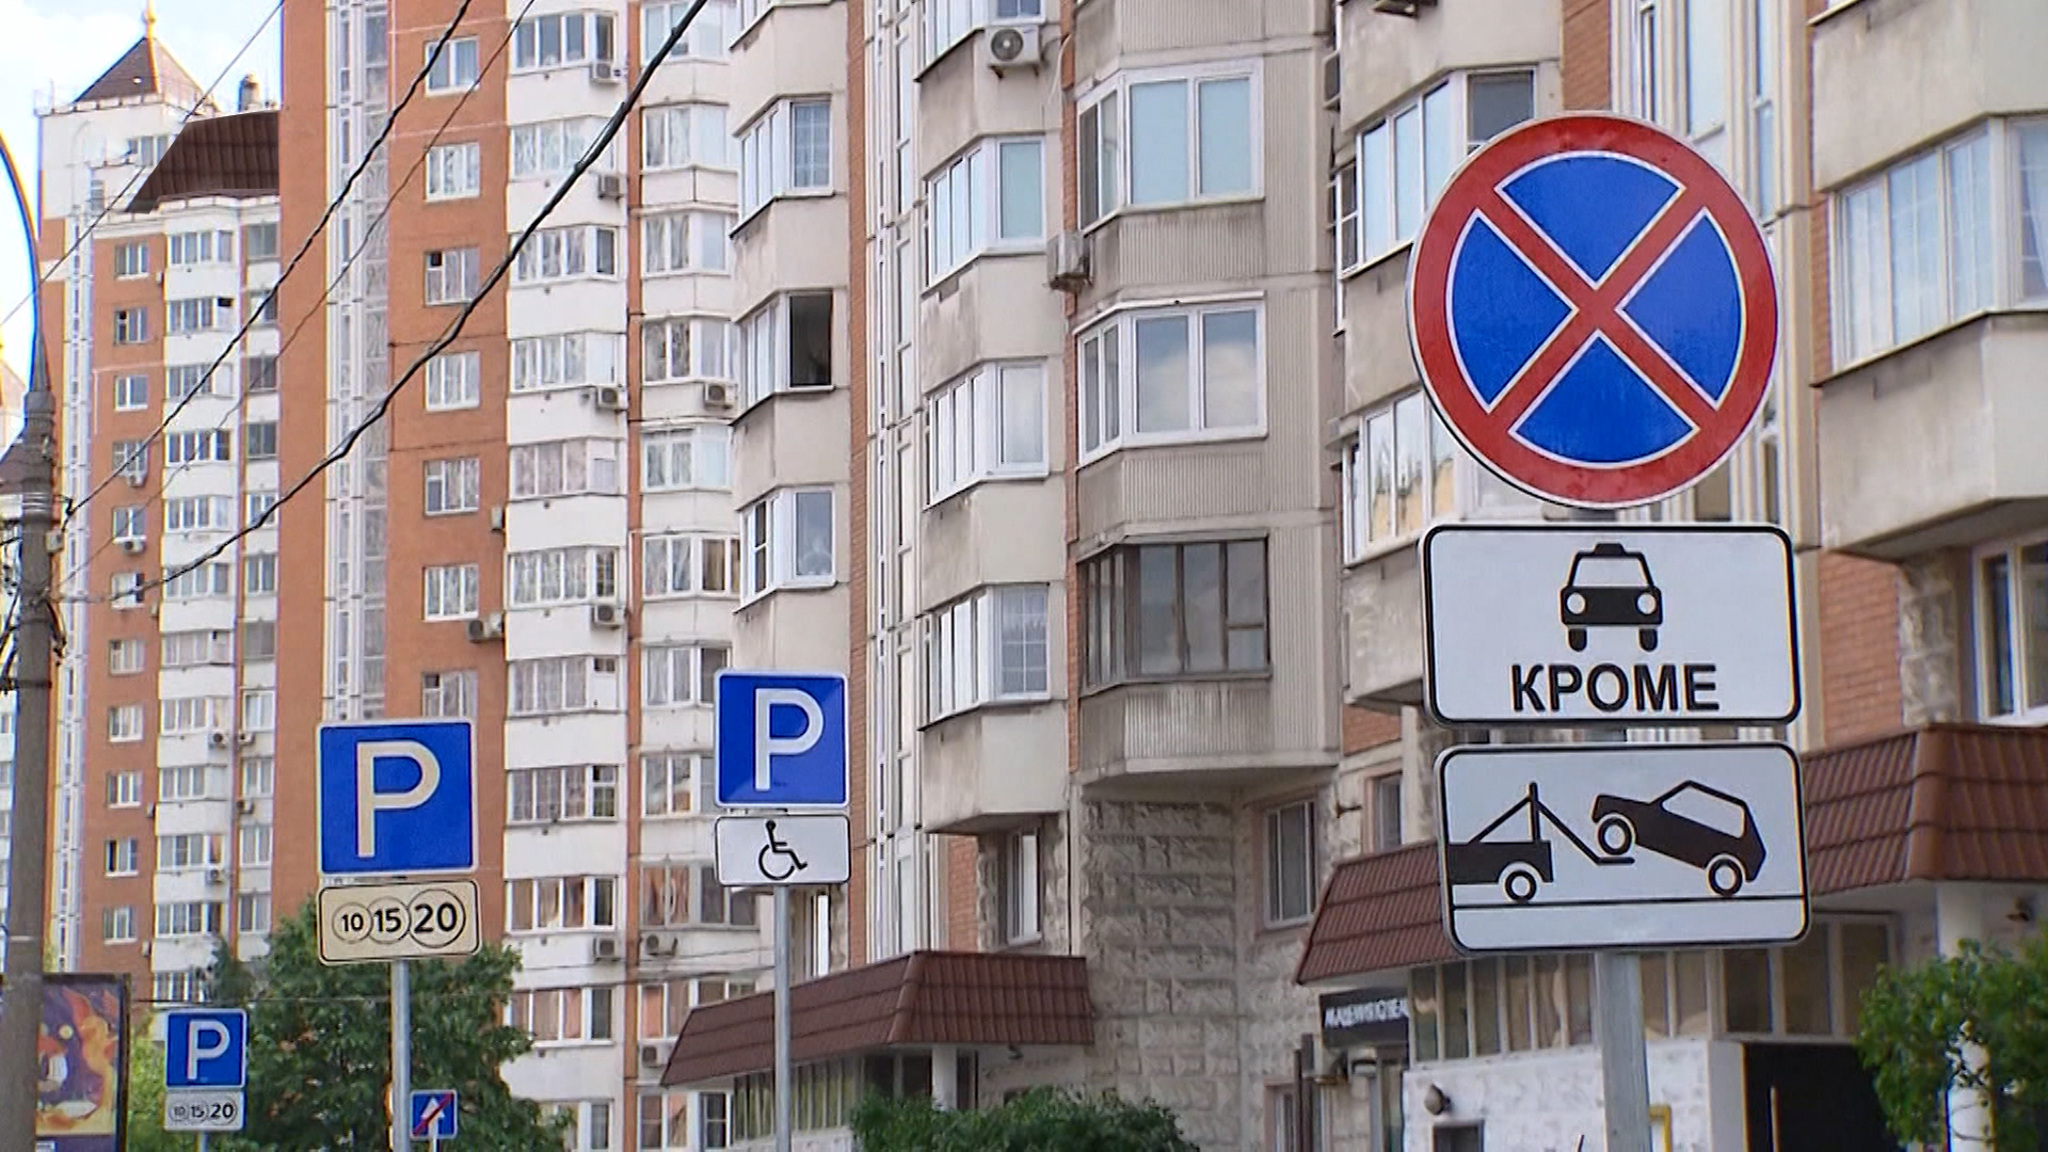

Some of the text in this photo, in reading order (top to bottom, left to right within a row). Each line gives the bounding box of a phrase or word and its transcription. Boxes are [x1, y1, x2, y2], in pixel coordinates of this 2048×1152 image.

[1511, 663, 1720, 713] КРОМЕ
[755, 688, 824, 791] P
[357, 740, 441, 858] P
[341, 902, 458, 934] 10 15 20
[187, 1020, 230, 1081] P
[210, 1103, 234, 1119] 20
